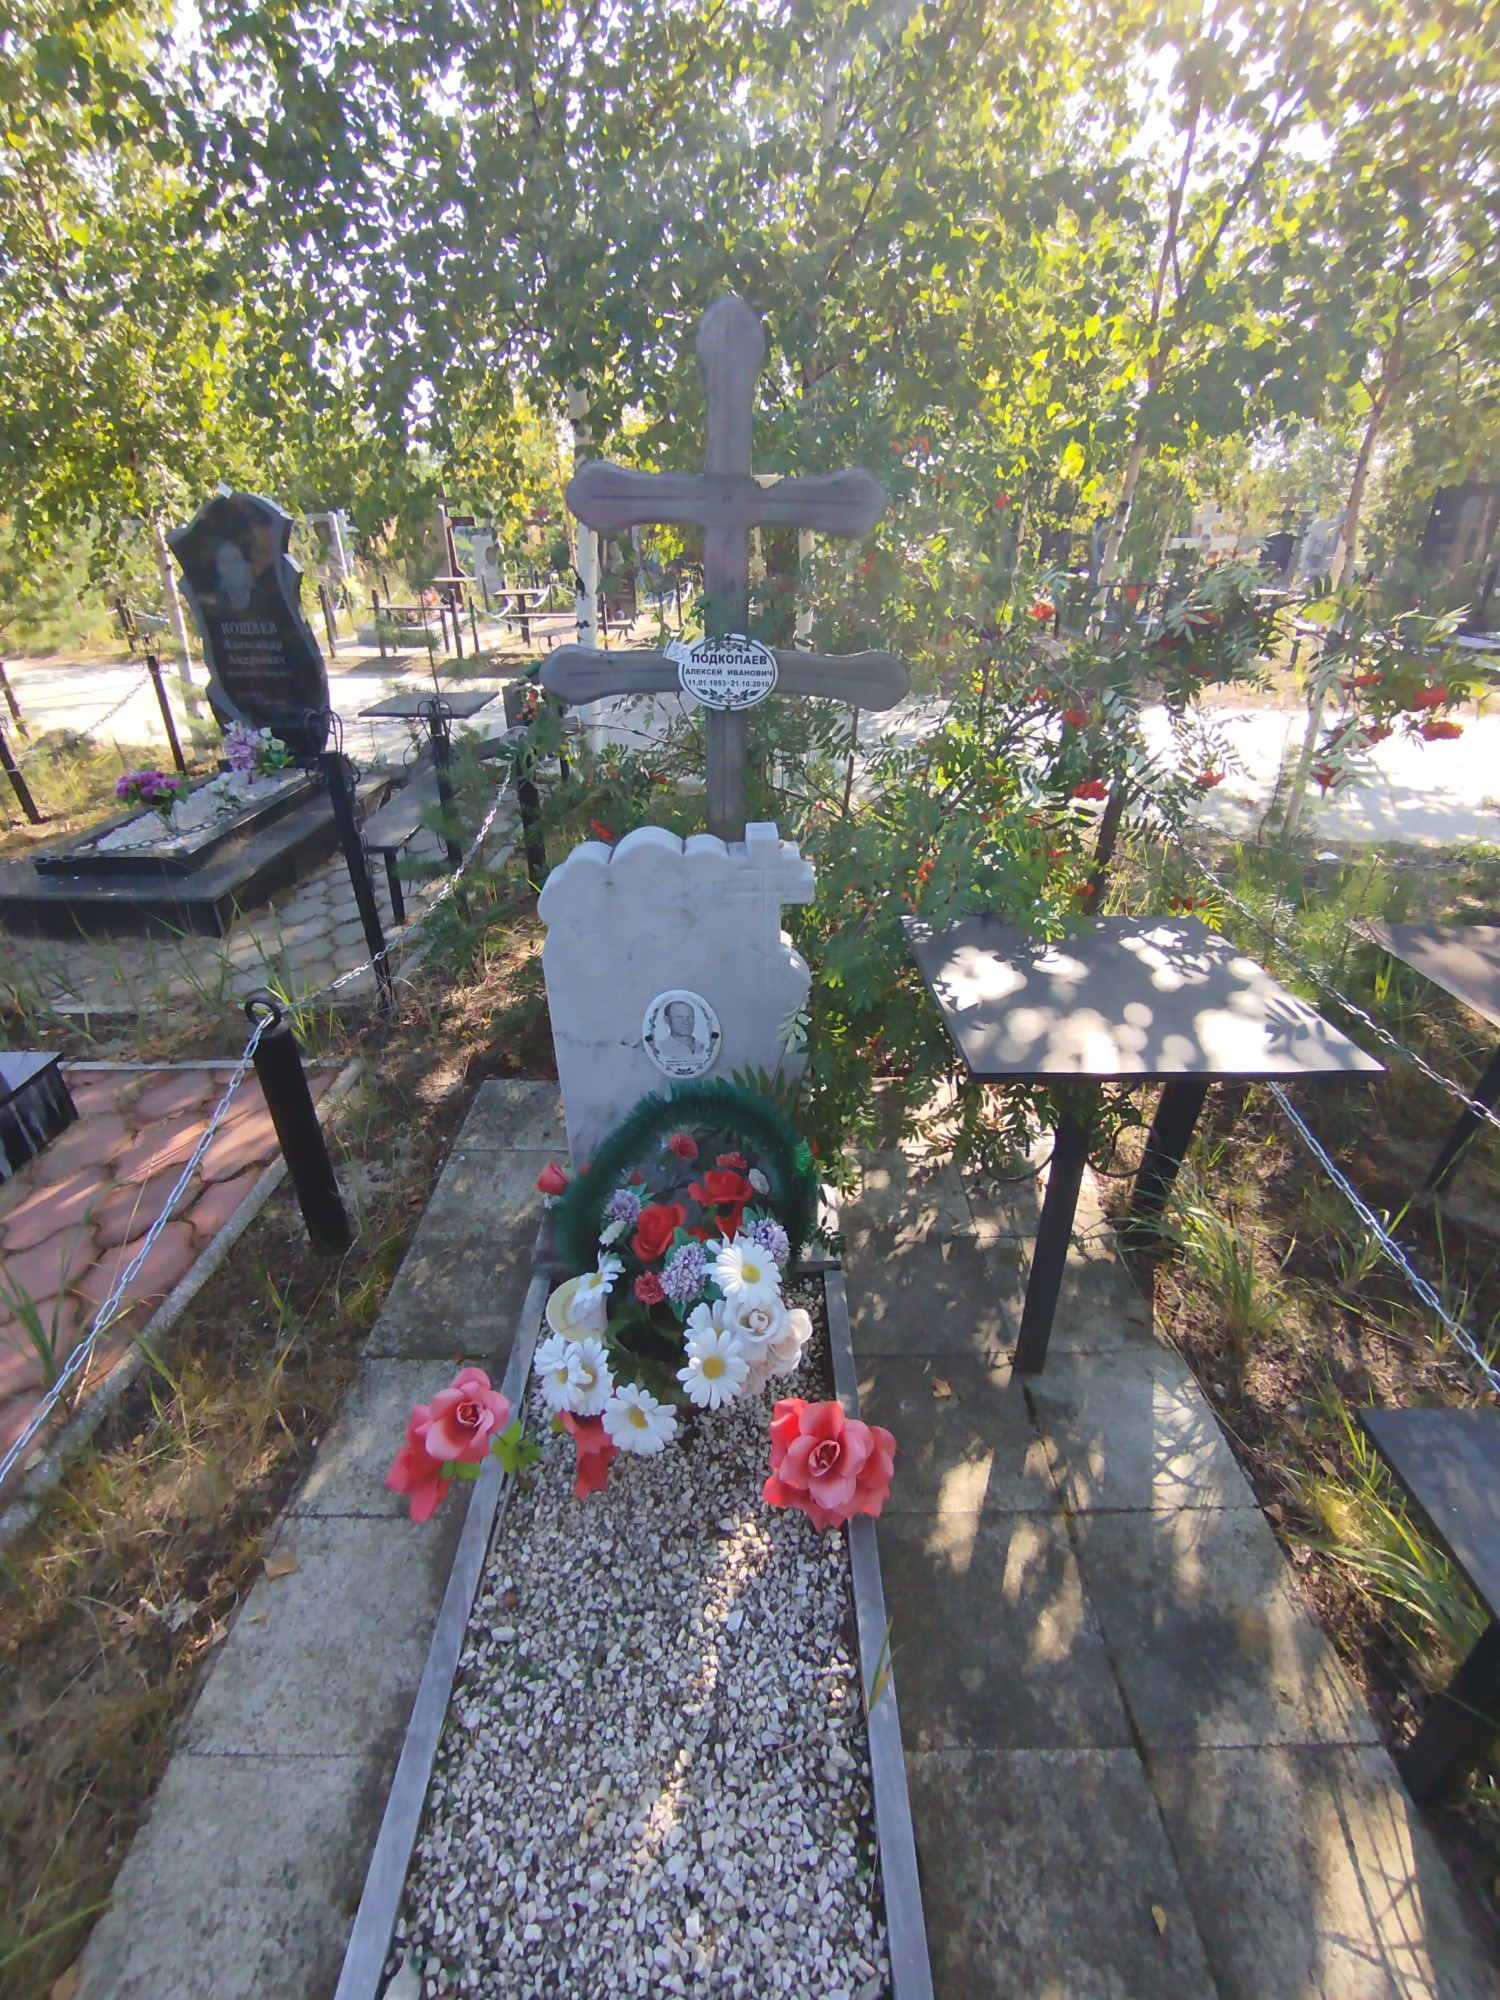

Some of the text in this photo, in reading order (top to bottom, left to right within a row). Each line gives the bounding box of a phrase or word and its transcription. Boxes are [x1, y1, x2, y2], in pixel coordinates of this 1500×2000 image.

[691, 653, 767, 665] ПОДКОПАЕВ
[685, 668, 773, 677] АЛЕКСЕЙ ИВАНОВИЧ
